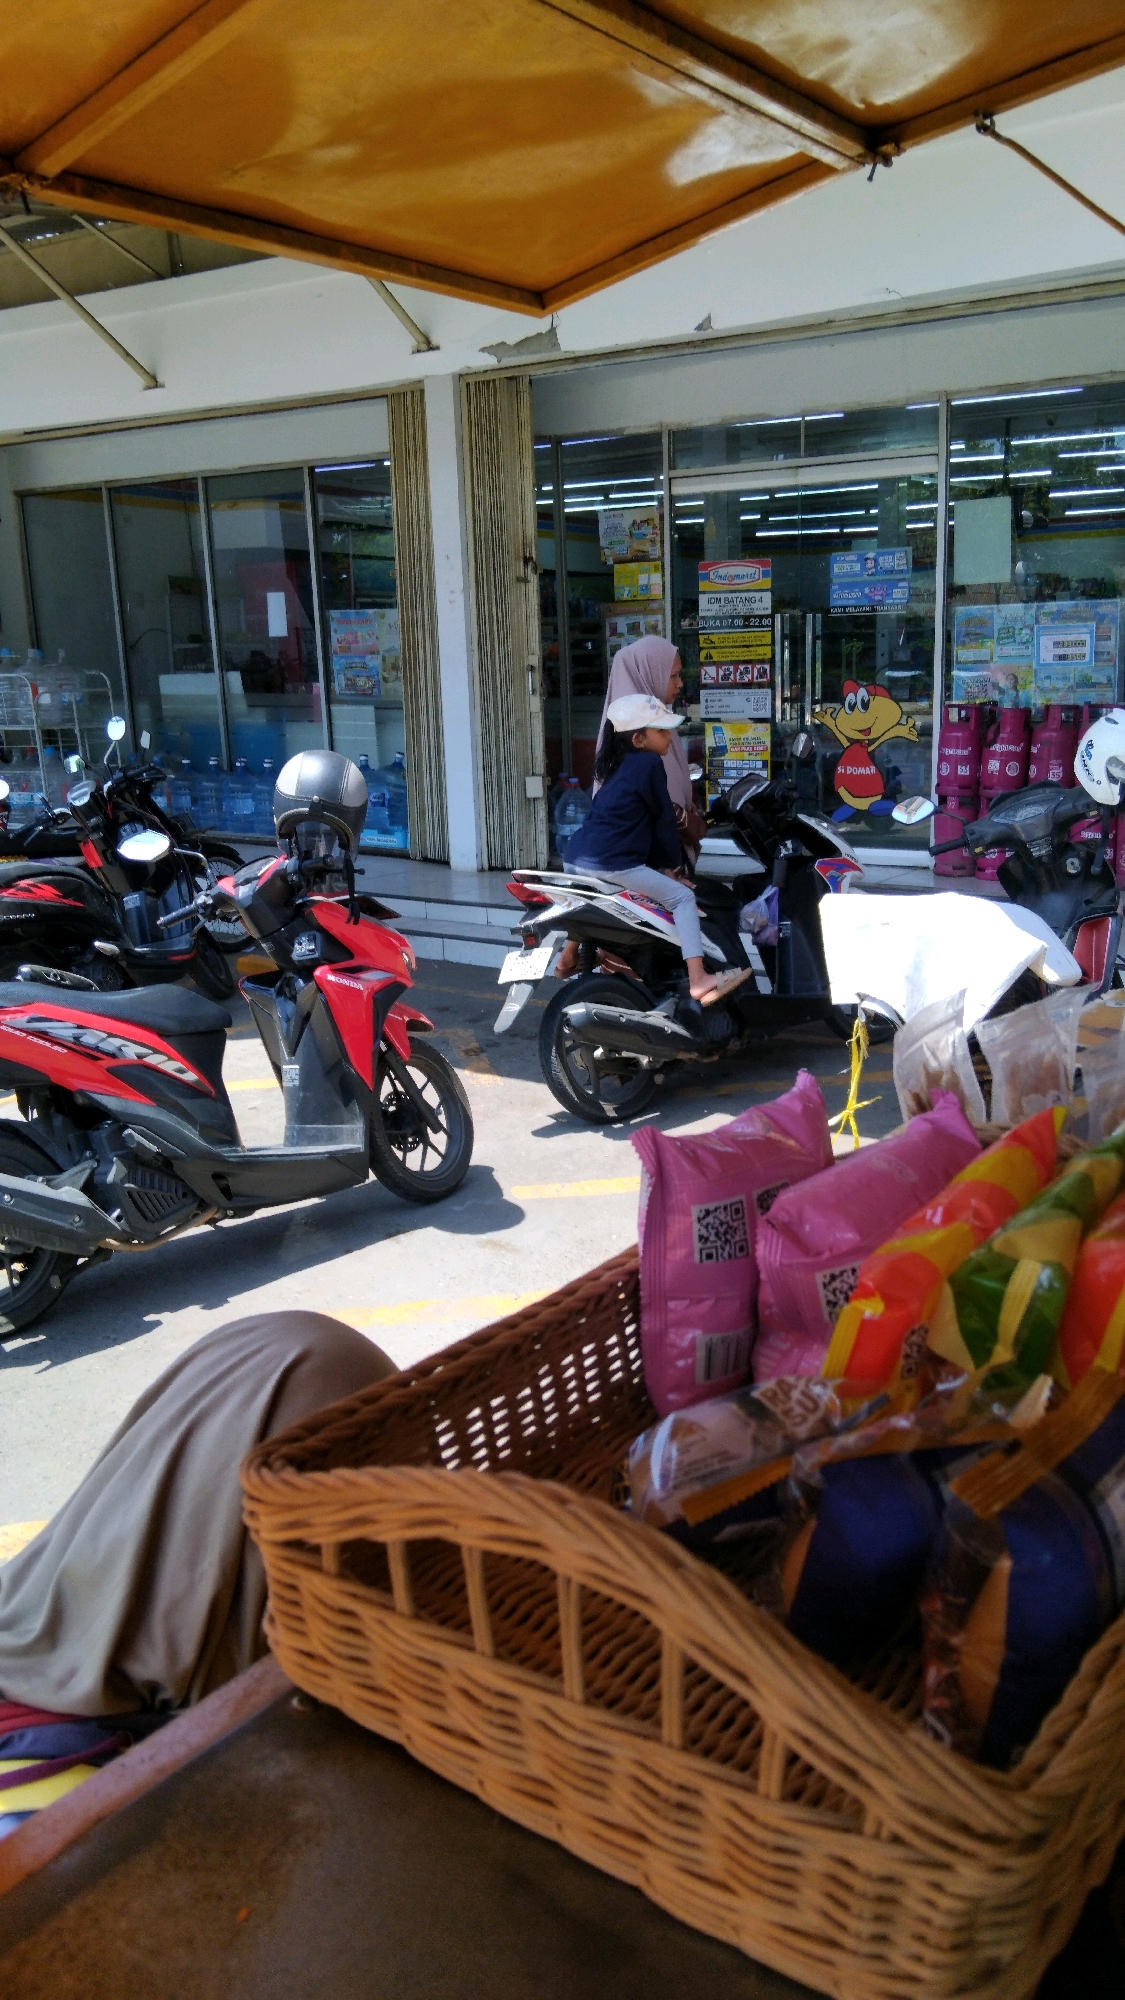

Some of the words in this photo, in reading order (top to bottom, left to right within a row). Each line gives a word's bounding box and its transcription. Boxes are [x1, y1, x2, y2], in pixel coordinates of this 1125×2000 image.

[708, 596, 722, 605] IDM
[724, 596, 757, 604] BATANG
[758, 596, 763, 604] 4
[699, 619, 720, 627] BUKA
[723, 618, 744, 626] 07.00
[749, 618, 772, 626] 22.00
[326, 973, 364, 991] HONDA
